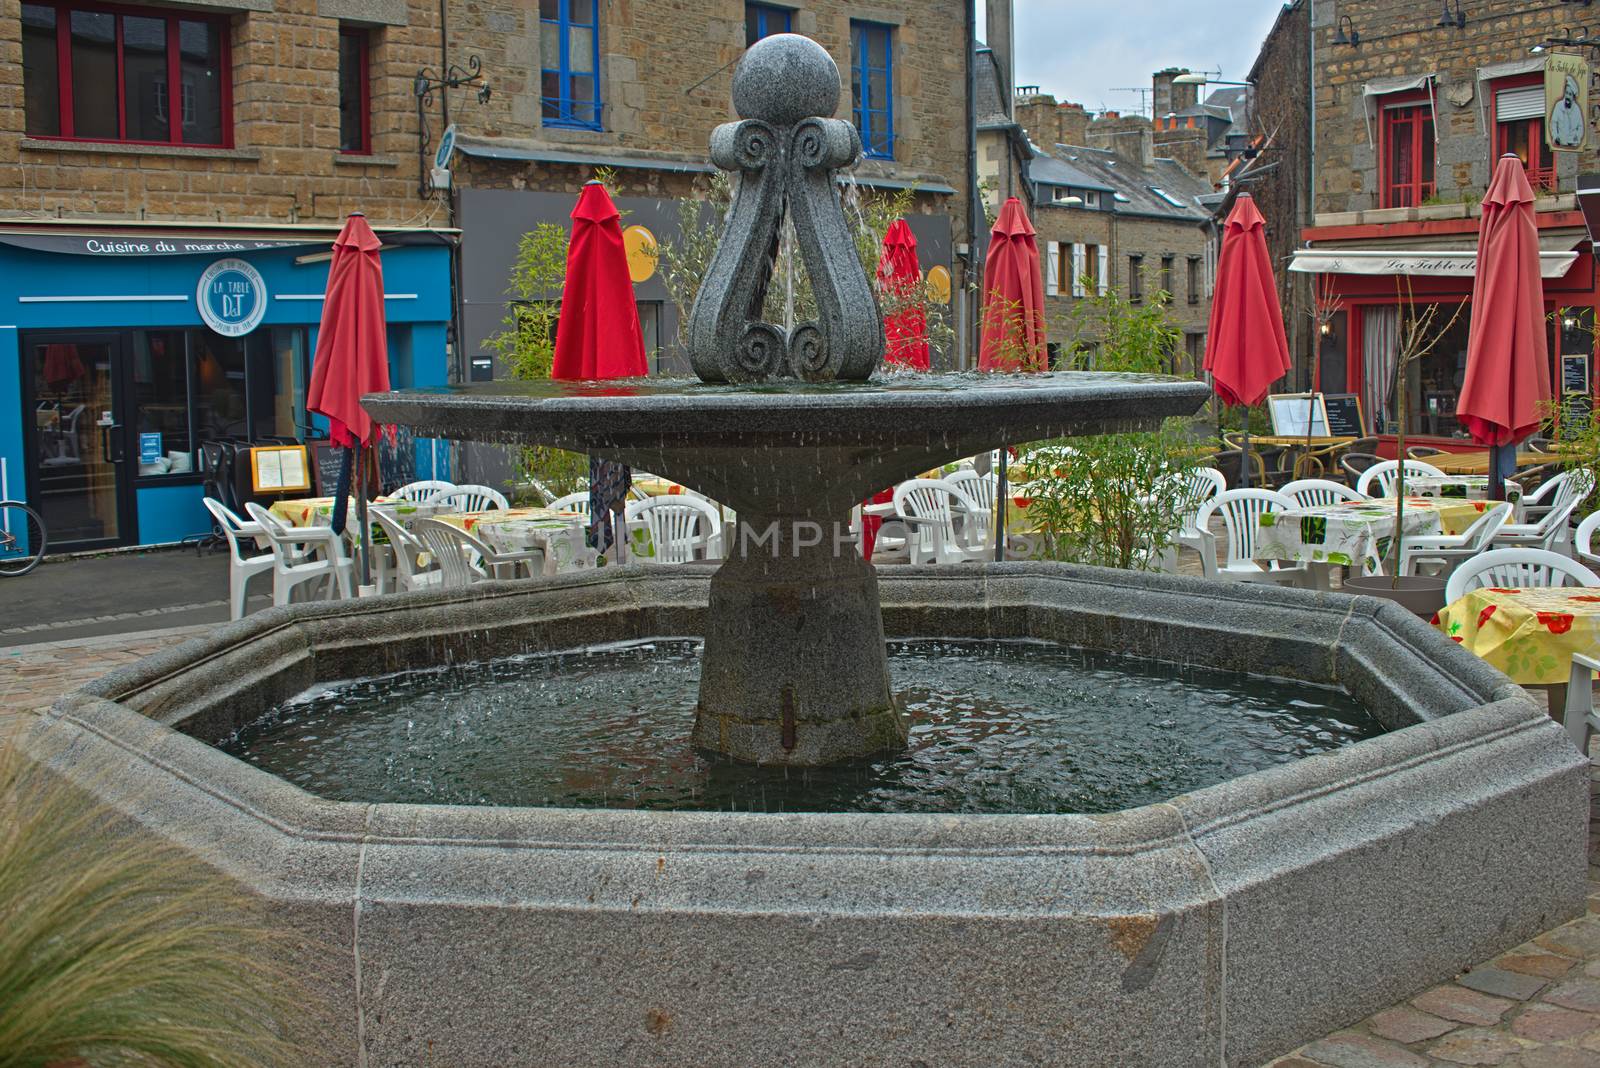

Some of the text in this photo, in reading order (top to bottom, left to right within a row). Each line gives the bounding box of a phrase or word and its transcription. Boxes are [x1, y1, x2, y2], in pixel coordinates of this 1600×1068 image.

[86, 239, 150, 253] Cuisine
[155, 241, 176, 252] du
[1386, 260, 1405, 269] La
[1410, 259, 1455, 270] Table
[213, 281, 250, 293] LA TABLE
